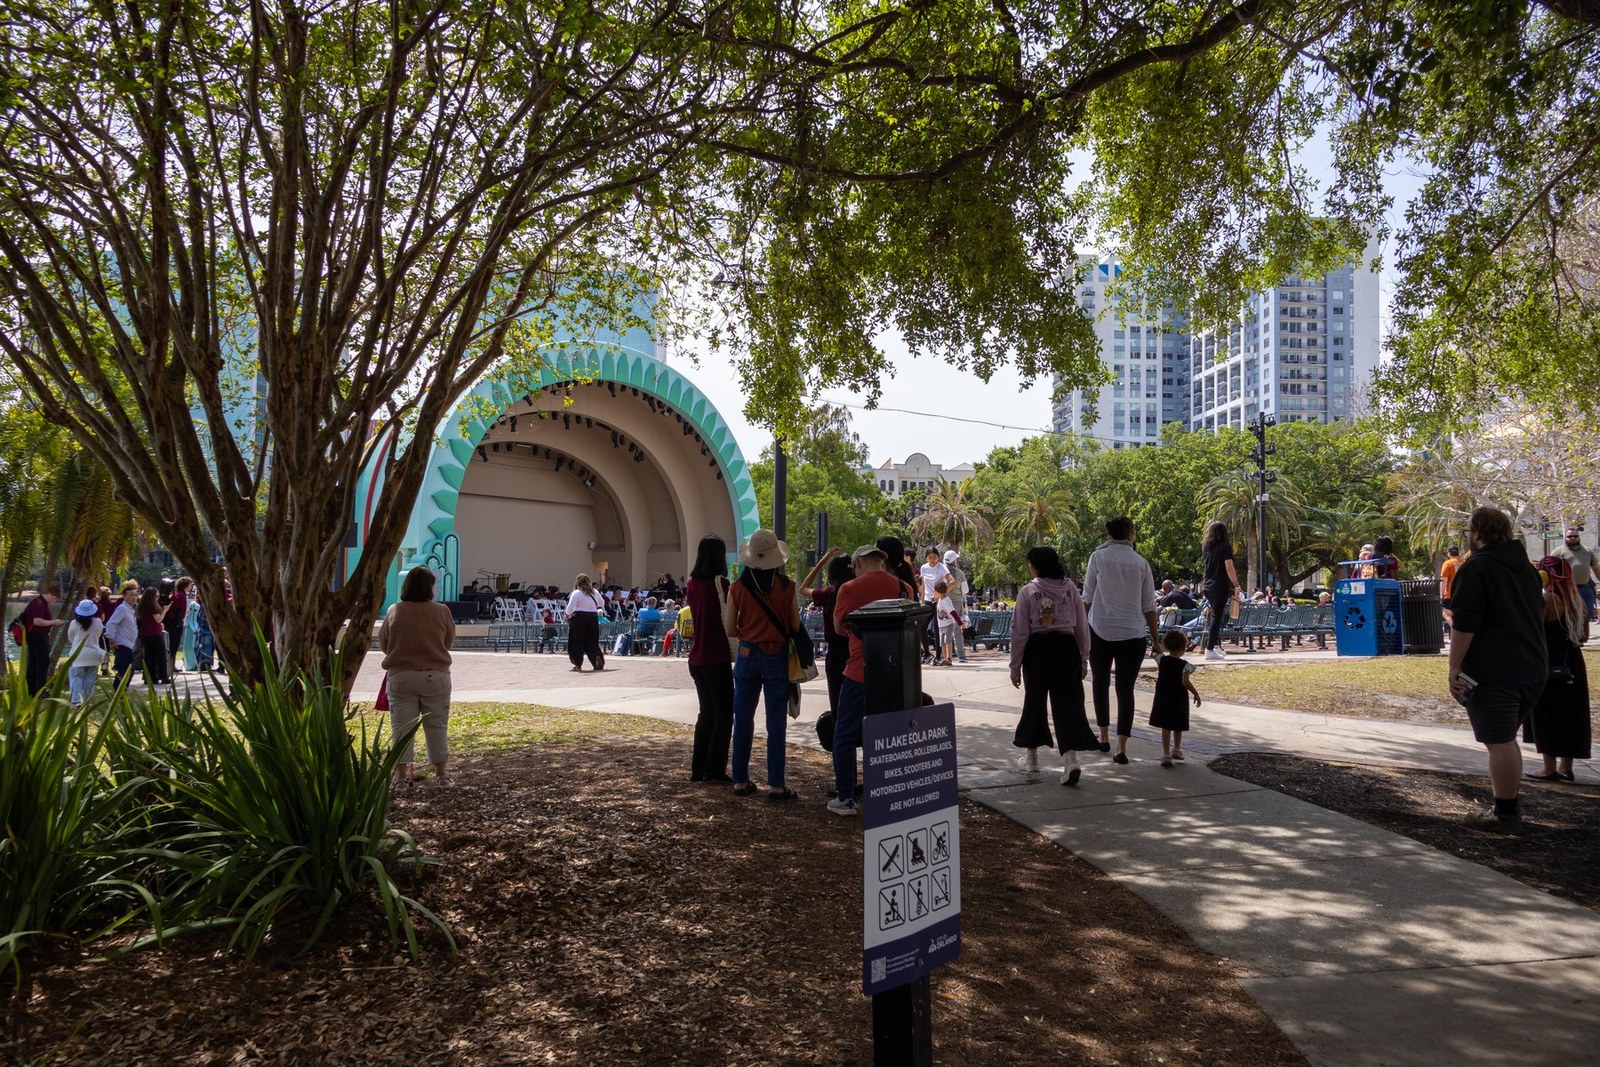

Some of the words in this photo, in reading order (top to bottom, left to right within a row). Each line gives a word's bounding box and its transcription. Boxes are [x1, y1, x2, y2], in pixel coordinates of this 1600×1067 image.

[875, 739, 884, 751] IN
[886, 735, 908, 749] LAKE
[908, 730, 928, 745] EOLA
[927, 726, 949, 740] PARK:
[869, 750, 914, 766] SKATEBOARDS,
[884, 768, 904, 779] BIKES,
[903, 760, 931, 775] SCOOTERS
[931, 758, 943, 768] AND
[870, 782, 906, 798] MOTORIZED
[890, 801, 903, 812] ARE
[903, 797, 915, 808] NOT
[914, 791, 940, 805] ALLOWED
